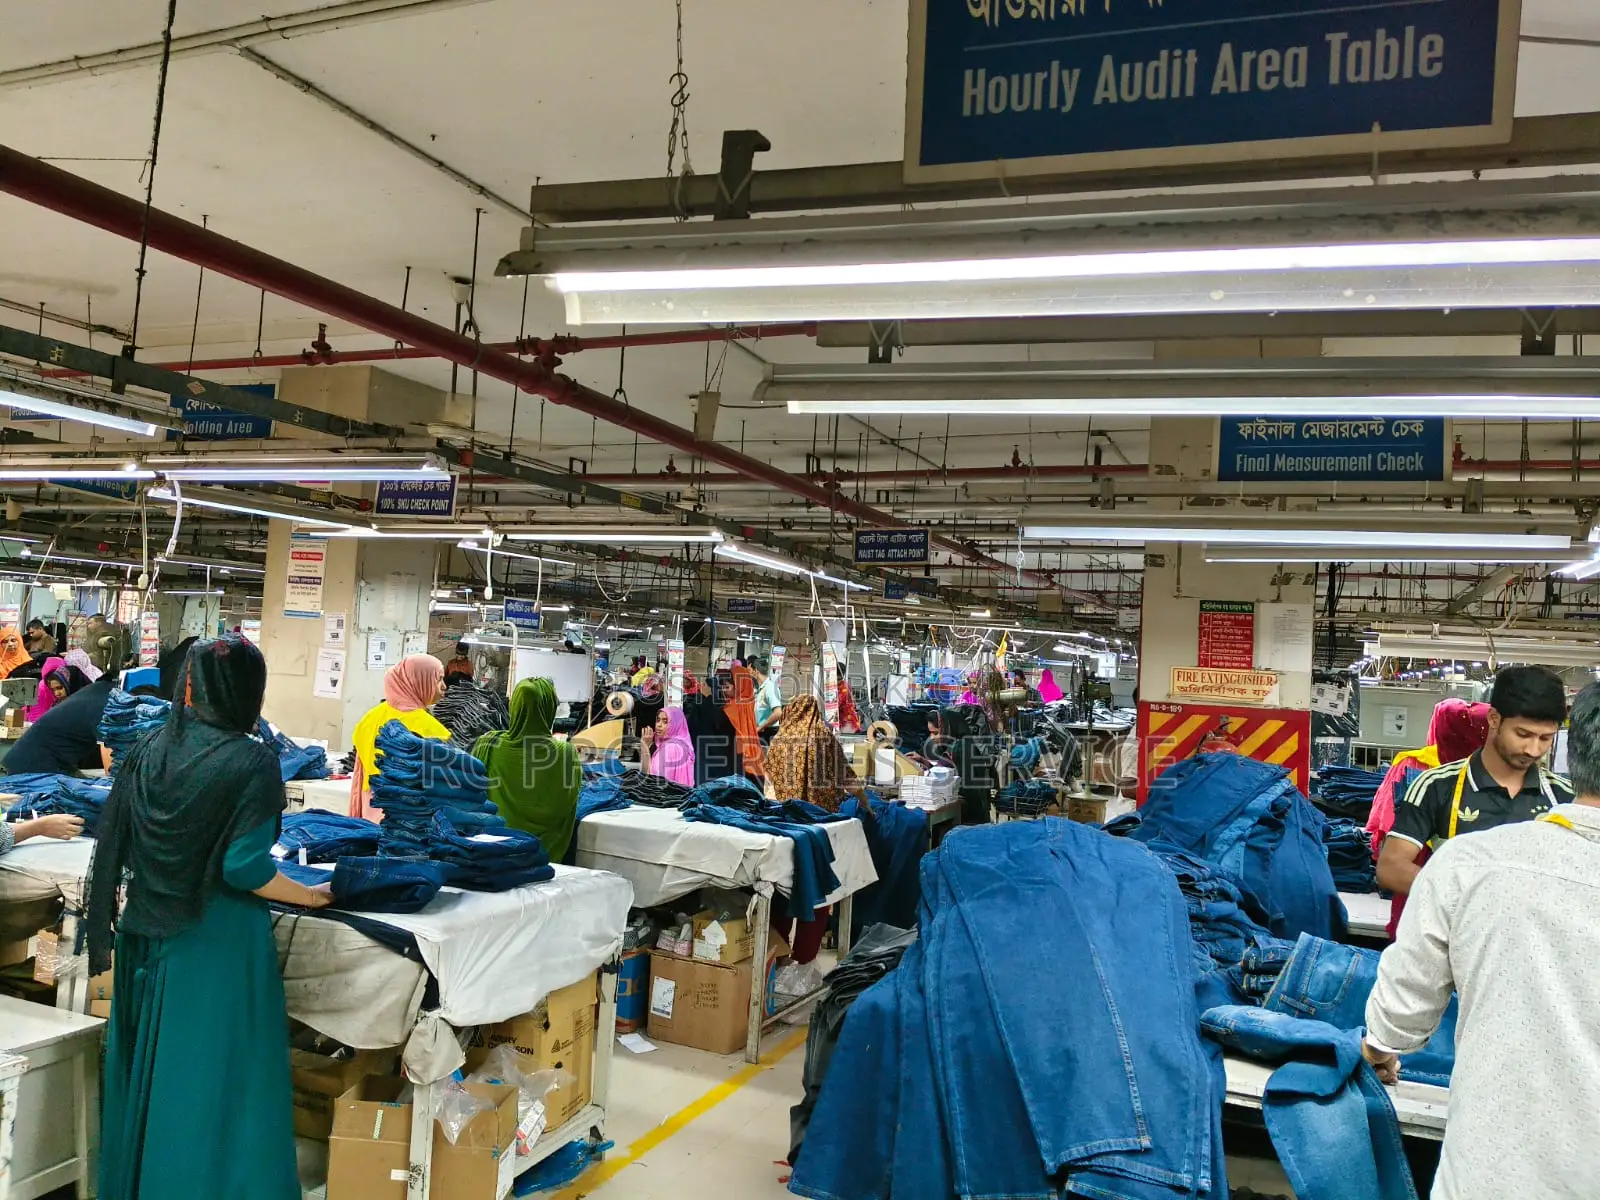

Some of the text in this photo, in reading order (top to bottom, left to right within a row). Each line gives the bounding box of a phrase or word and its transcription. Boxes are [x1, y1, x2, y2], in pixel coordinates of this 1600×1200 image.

[962, 25, 1444, 117] Hourly Audit Area Table
[186, 420, 253, 435] olding Area
[1236, 416, 1296, 441] ফাইনাল
[1392, 419, 1425, 438] চেক
[1236, 451, 1424, 473] Final Measurement Check
[410, 499, 430, 511] CHECK
[431, 499, 450, 511] POINT
[858, 549, 924, 559] WAIST TAG ATTACH POINT
[1176, 671, 1274, 686] FIRE EXTINGUISHER
